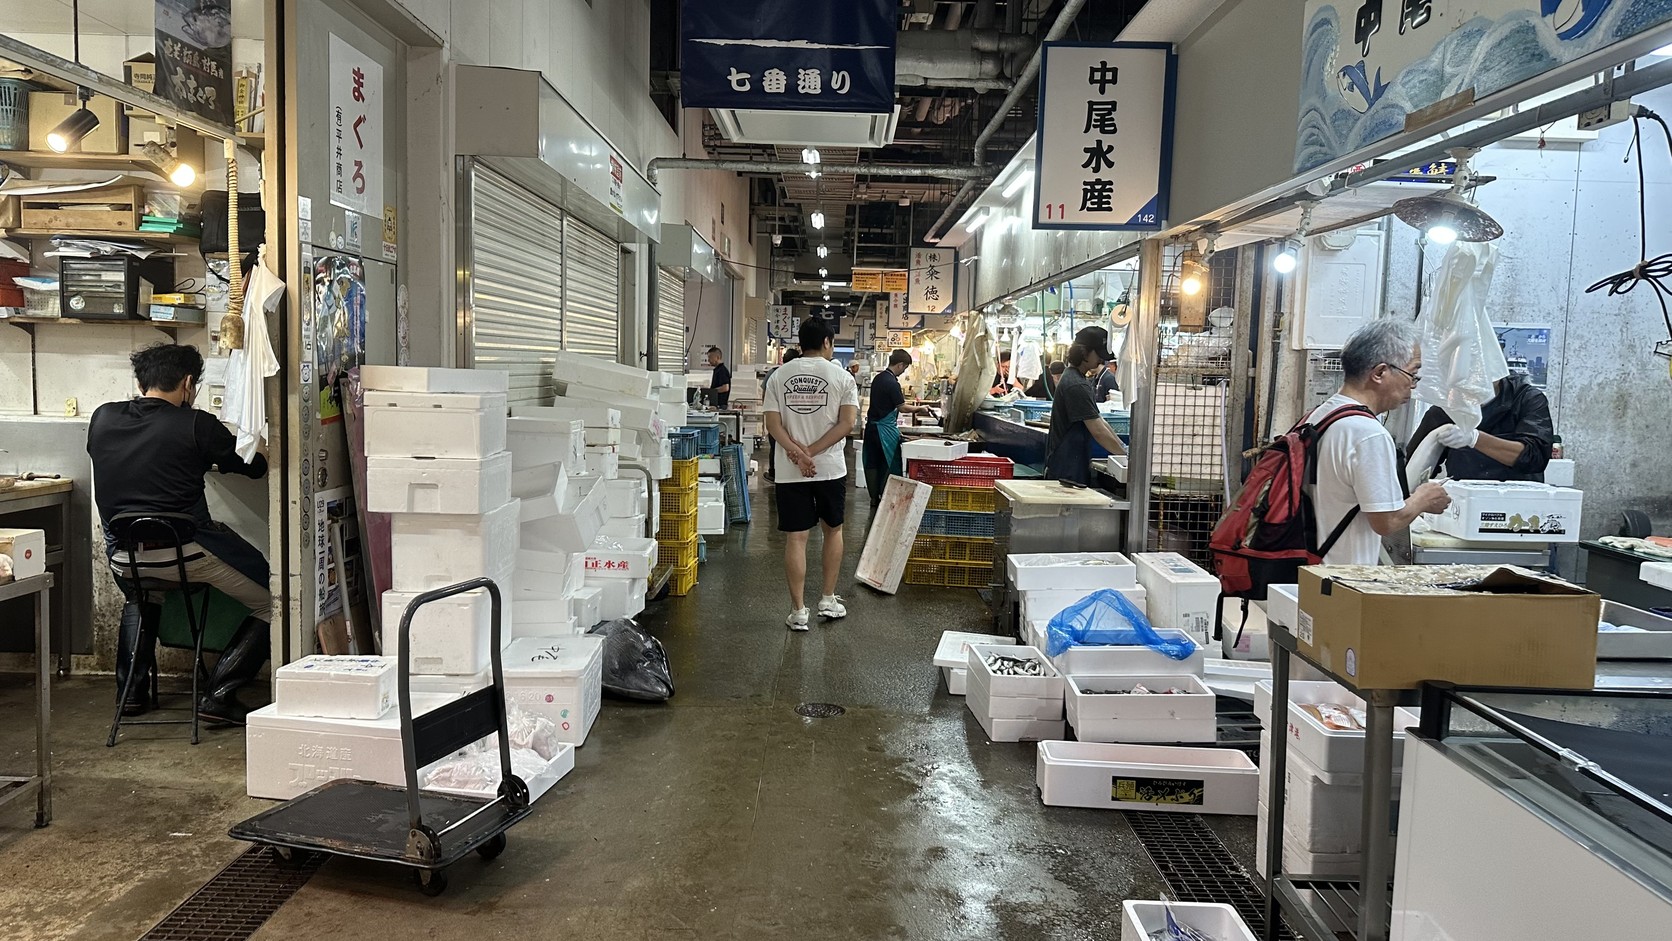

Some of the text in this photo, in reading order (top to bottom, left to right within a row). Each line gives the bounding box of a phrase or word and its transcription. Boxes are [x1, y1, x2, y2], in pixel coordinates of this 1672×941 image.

[727, 67, 851, 95] 七番通り
[352, 66, 367, 195] まぐろ
[1078, 60, 1119, 212] 中尾水産
[1046, 203, 1065, 220] 11
[1137, 213, 1155, 223] 142
[819, 308, 835, 320] 七
[927, 304, 937, 312] 12
[781, 306, 790, 333] まぐろ
[790, 377, 822, 386] CONQUEST
[793, 384, 818, 395] Quality
[298, 743, 352, 761] 北海道産
